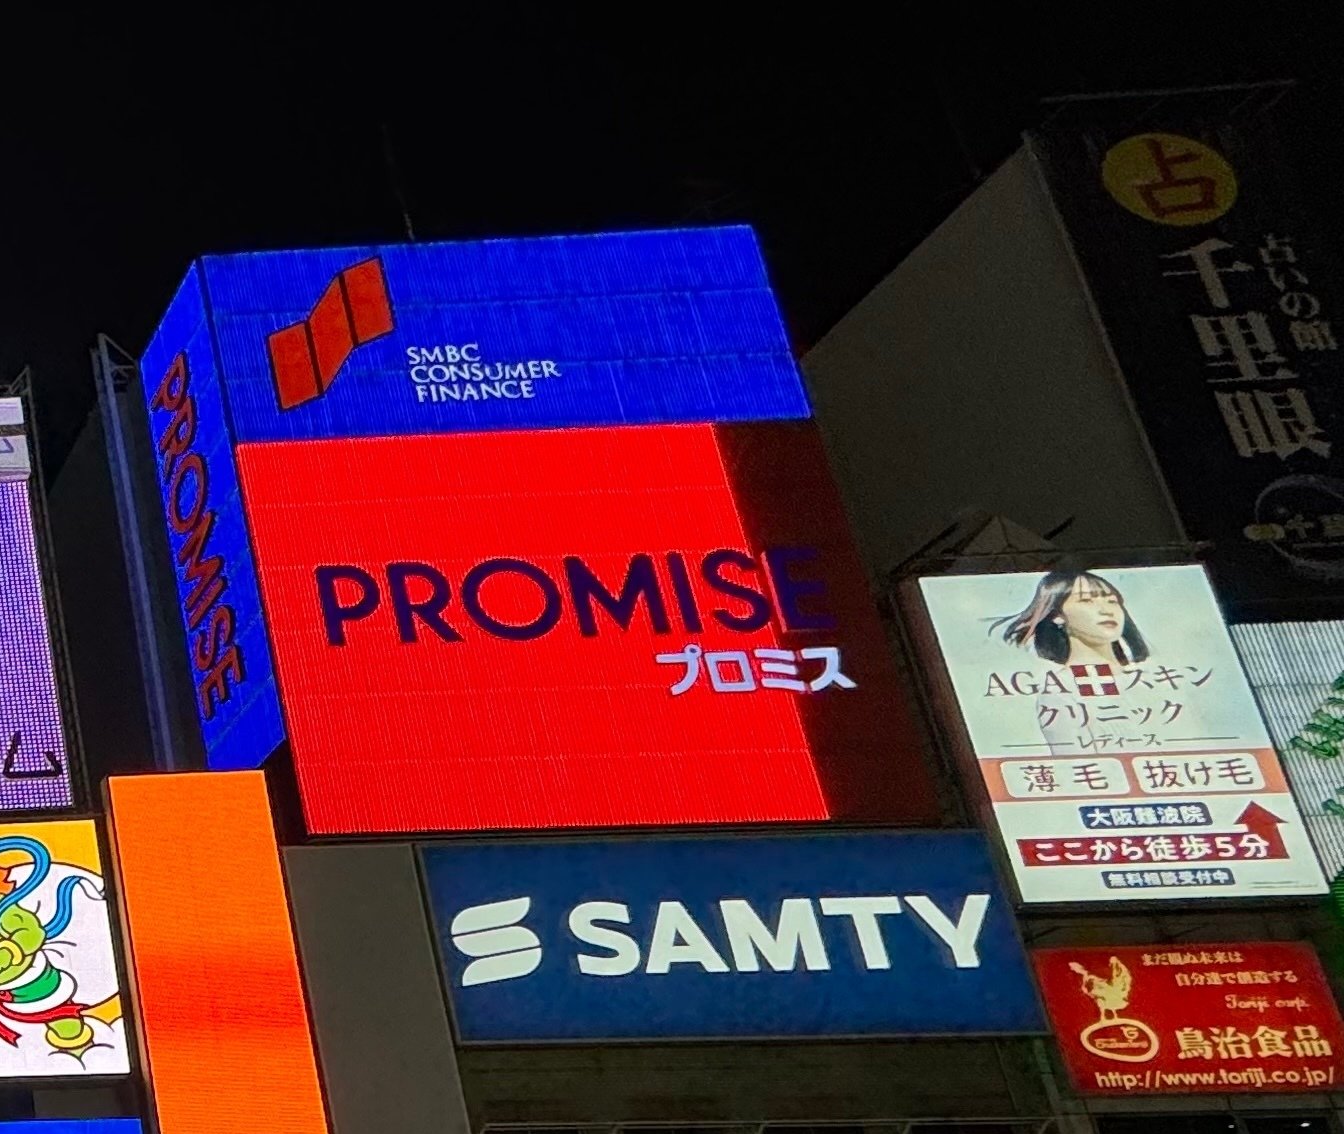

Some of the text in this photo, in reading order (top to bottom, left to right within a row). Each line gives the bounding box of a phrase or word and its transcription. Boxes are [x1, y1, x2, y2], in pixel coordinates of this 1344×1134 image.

[406, 343, 481, 365] SMBC
[1158, 237, 1333, 459] 千里眼
[410, 360, 562, 383] CONSUMER
[415, 380, 536, 403] FINANCE
[150, 352, 242, 720] PROMISE
[315, 548, 838, 648] PROMISE
[656, 644, 857, 695] プロミス
[984, 664, 1214, 698] AGA スキン
[1038, 700, 1184, 730] クリニック
[1077, 734, 1163, 750] レディース
[1019, 762, 1110, 794] 薄毛
[1143, 758, 1255, 788] 抜け毛
[1087, 805, 1210, 827] 大阪難波院
[1036, 835, 1271, 863] ここから徒歩5分
[569, 893, 991, 977] SAMTY
[1175, 1025, 1332, 1060] 鳥治食品
[1095, 1066, 1334, 1090] http://www.toriji.co.jp/
